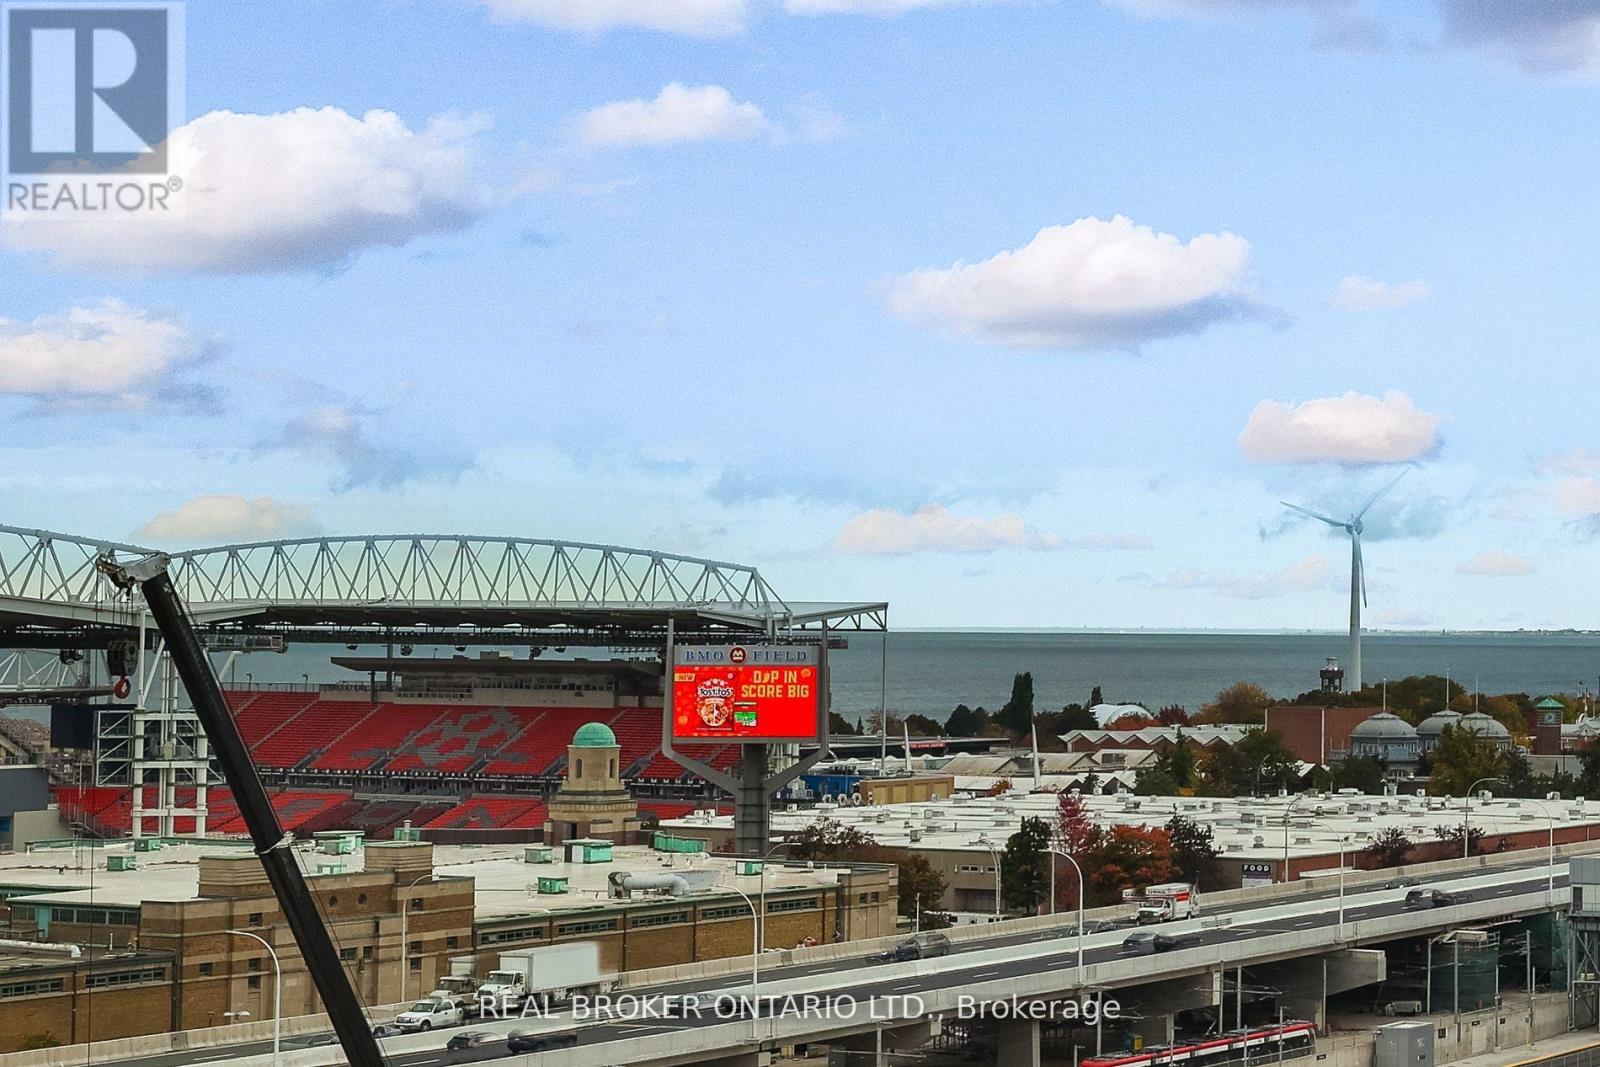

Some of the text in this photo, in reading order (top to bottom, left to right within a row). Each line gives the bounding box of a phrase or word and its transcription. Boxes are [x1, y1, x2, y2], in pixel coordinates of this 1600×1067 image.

[685, 650, 807, 661] BMO FIELD
[784, 670, 798, 684] IN
[741, 684, 809, 698] SCORE BIG
[1243, 864, 1269, 872] FOOD
